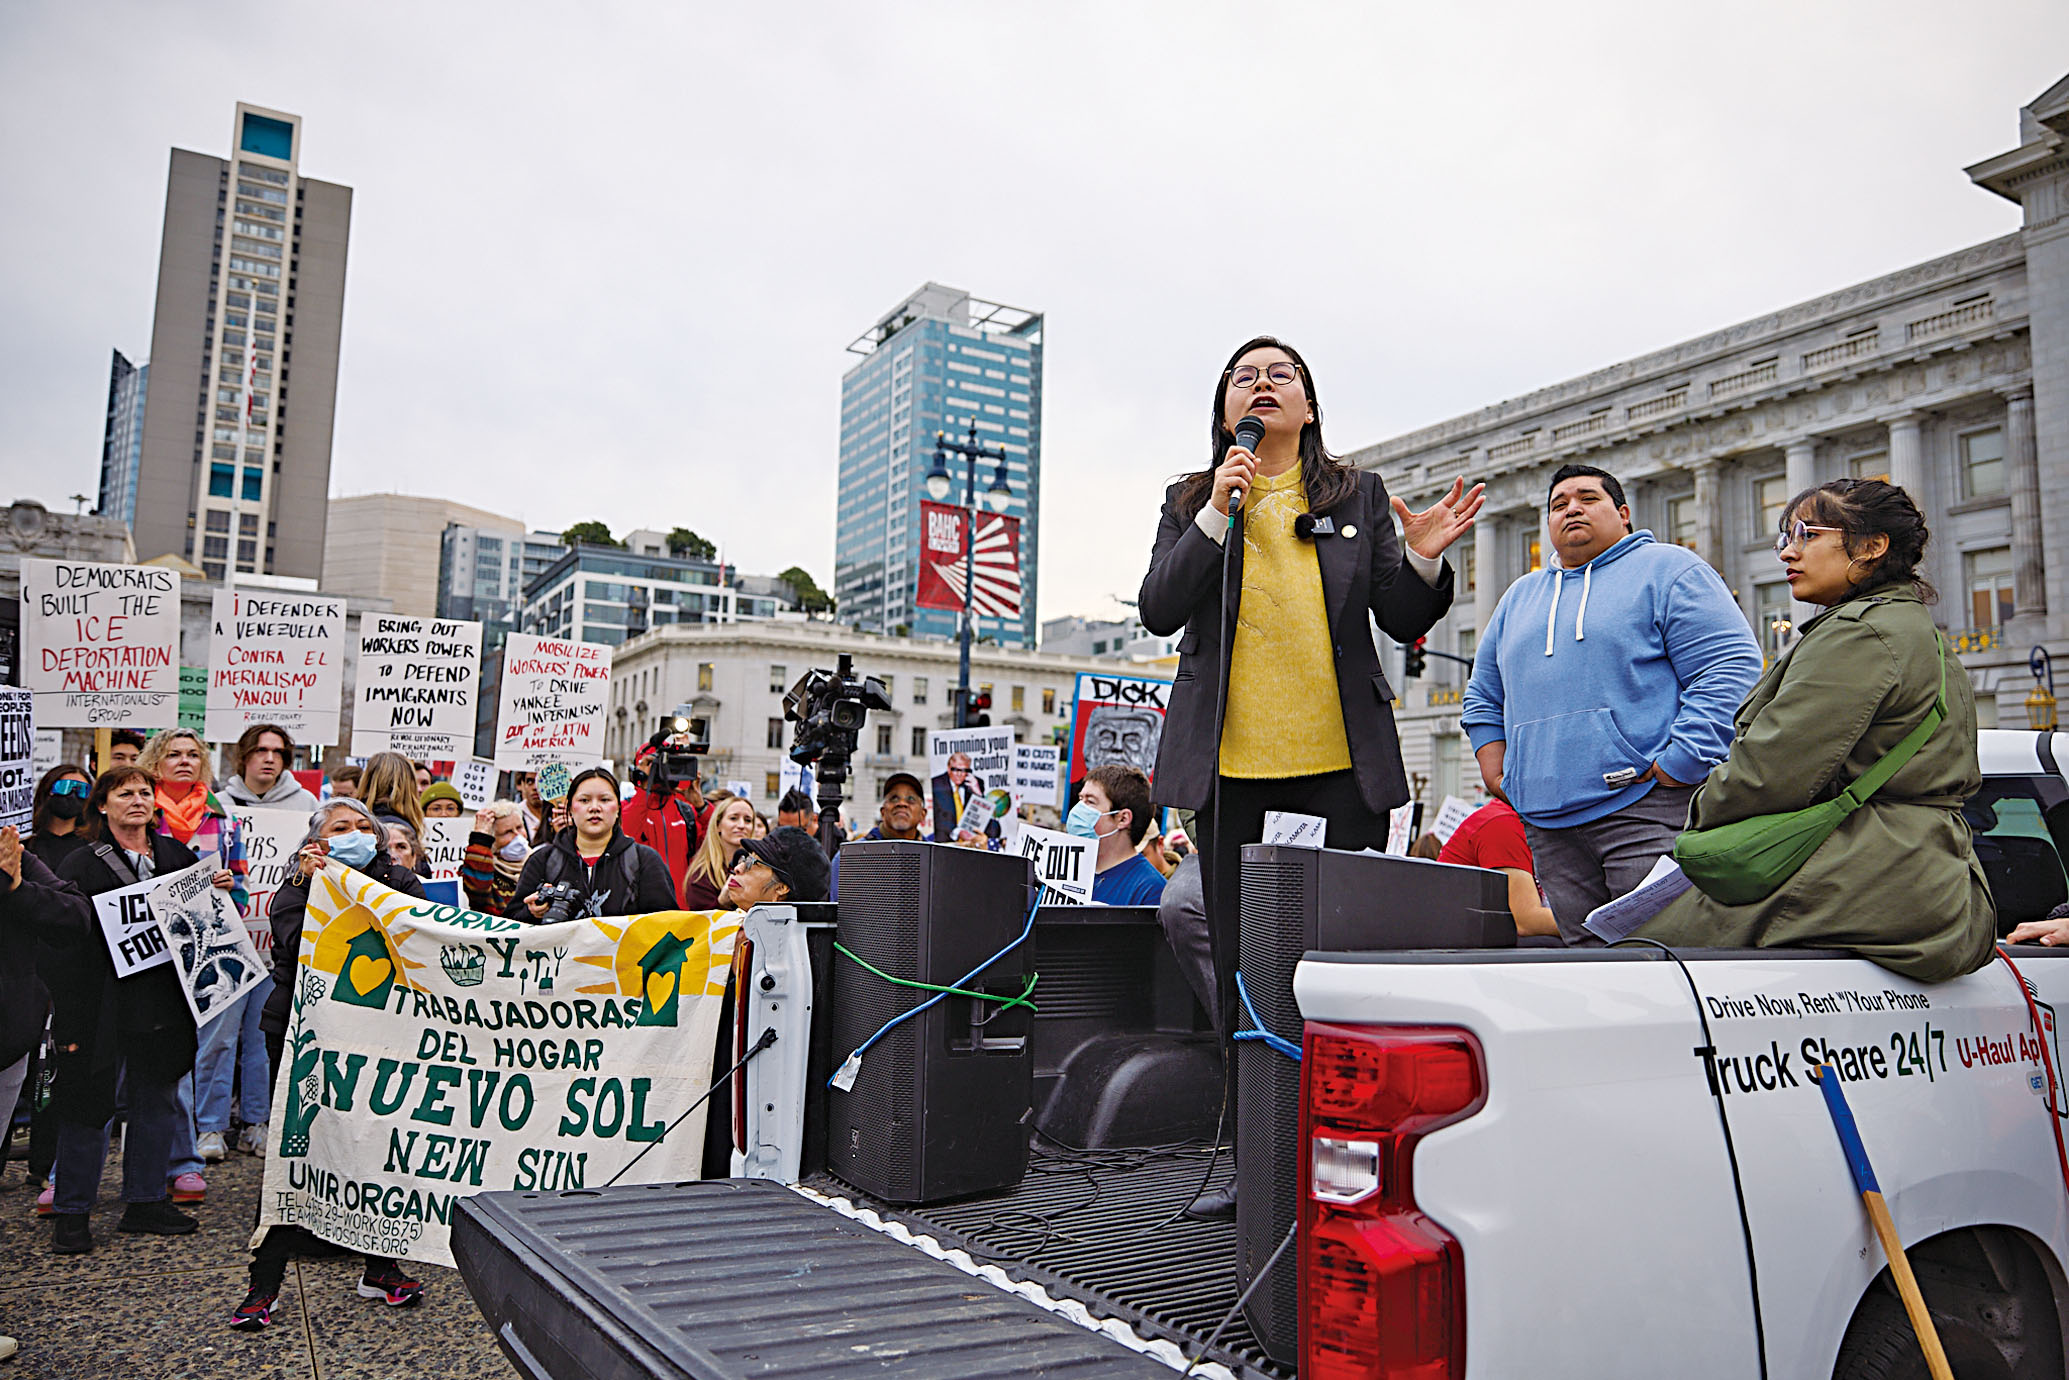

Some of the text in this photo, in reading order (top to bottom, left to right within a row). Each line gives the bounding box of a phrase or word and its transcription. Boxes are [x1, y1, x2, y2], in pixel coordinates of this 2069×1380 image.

[928, 511, 960, 540] BAHC
[56, 565, 173, 592] DEMOCRATS
[41, 591, 161, 617] BUILT THE
[247, 599, 339, 618] DEFENDER
[77, 616, 128, 642] ICE
[215, 621, 329, 640] A VENEZUELA
[378, 619, 464, 638] BRING OUT
[361, 637, 475, 659] WORKERS POWER
[533, 642, 601, 660] MOBILIZE
[42, 644, 172, 672] DEPORTATION
[304, 650, 328, 666] EL
[62, 669, 157, 693] MACHINE
[214, 669, 317, 688] IMERIALISMO
[379, 663, 471, 683] TO DEFEND
[573, 662, 609, 681] POWER
[530, 679, 589, 694] TO DRIVE
[1091, 677, 1165, 709] DICK
[65, 693, 168, 708] INTERNATIONALIST
[233, 688, 288, 709] YANQUI
[365, 687, 468, 706] IMMIGRANTS
[513, 693, 563, 712] YANKEE
[87, 709, 132, 723] GROUP
[390, 707, 434, 727] NOW
[527, 702, 604, 726] IMPERIALISM
[506, 722, 590, 740] OUT OF LATIN
[521, 737, 576, 750] AMERICA
[933, 734, 1009, 756] I'm running your
[1017, 747, 1031, 758] NO
[468, 763, 486, 773] ICE
[541, 763, 564, 778] LOVE
[973, 752, 1009, 771] country
[1016, 760, 1029, 770] NO
[464, 773, 485, 782] OUT
[1016, 777, 1028, 787] NO
[460, 792, 485, 803] OOD
[1045, 845, 1085, 882] OUT
[168, 870, 200, 898] STRIKE
[485, 937, 520, 978] Y
[394, 983, 644, 1030] TRABAJADORAS
[1705, 995, 1756, 1020] Drive
[1759, 993, 1803, 1020] Now,
[1798, 991, 1836, 1015] Rent
[1886, 989, 1930, 1012] Phone
[416, 1028, 604, 1071] DEL HOGAR
[1693, 1041, 1800, 1097] Truck
[1800, 1036, 1888, 1087] Share
[1890, 1020, 1948, 1083] 24/7
[1956, 1032, 2017, 1069] U-Haul
[2030, 1075, 2044, 1090] GET
[321, 1050, 666, 1144] NUEVO SOL
[384, 1127, 588, 1191] NEW SUN
